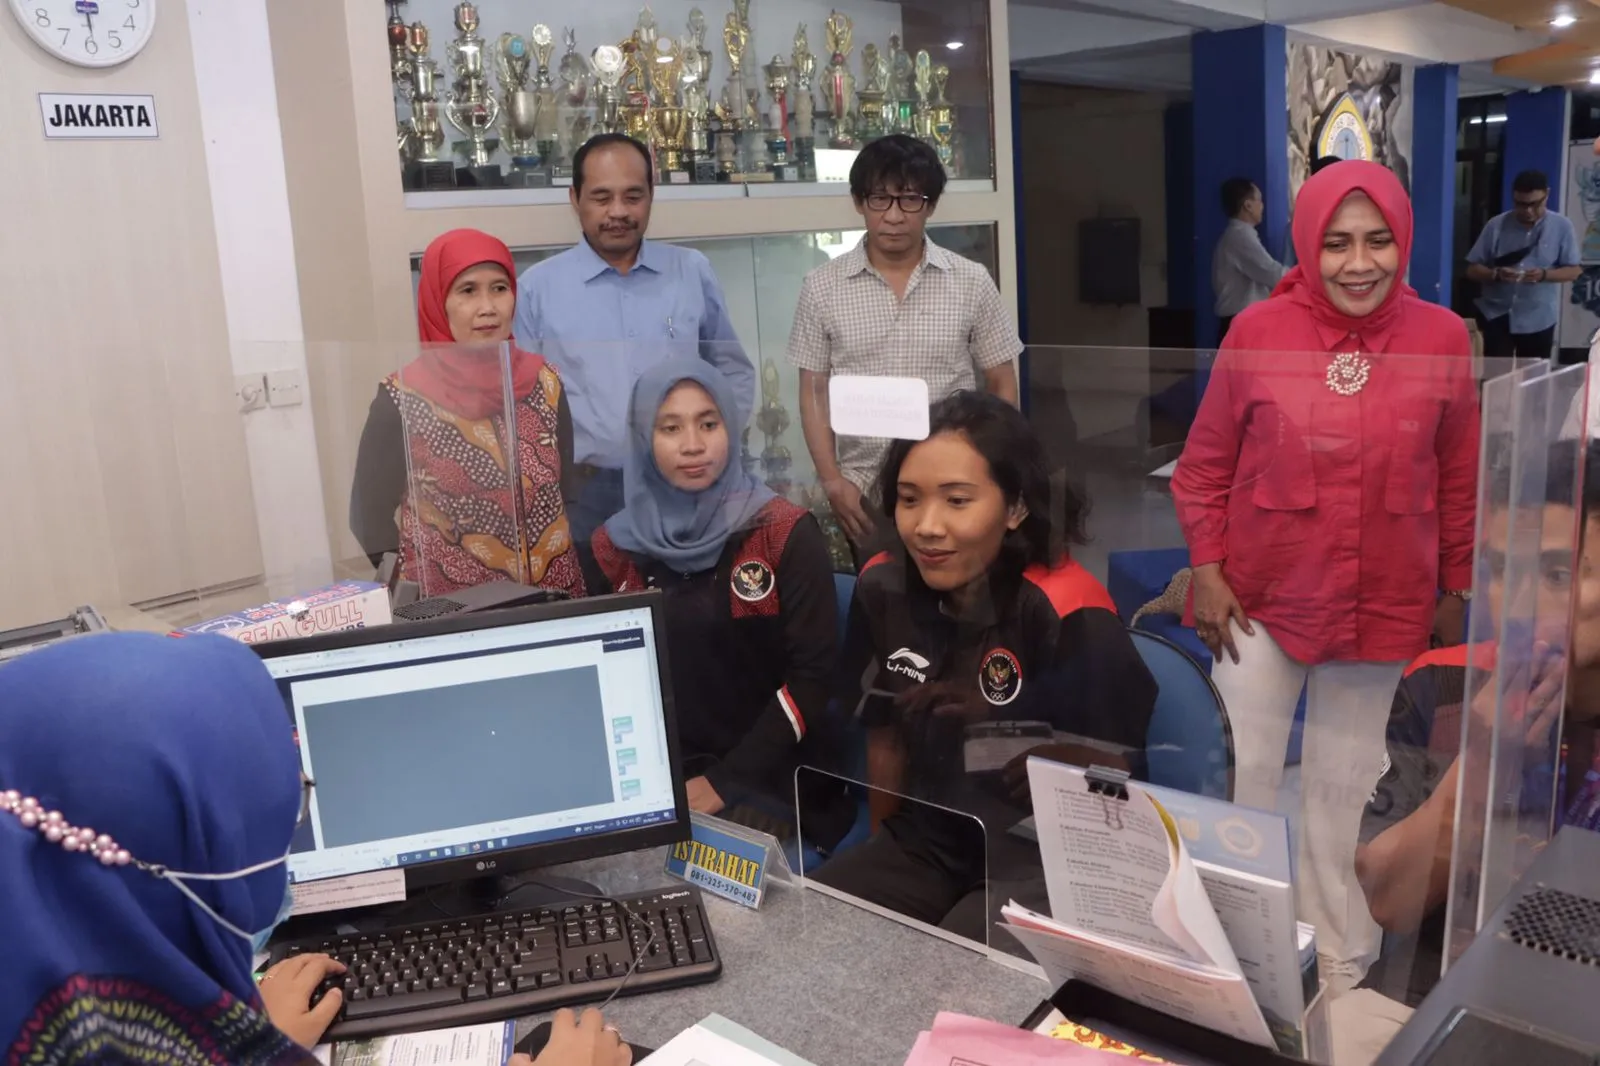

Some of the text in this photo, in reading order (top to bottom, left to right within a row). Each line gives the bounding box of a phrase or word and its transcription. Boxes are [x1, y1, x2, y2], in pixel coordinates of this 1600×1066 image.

[35, 8, 51, 27] 8
[122, 14, 136, 31] 4
[57, 28, 70, 46] 7
[84, 35, 99, 55] 6
[108, 30, 122, 49] 5
[49, 103, 151, 127] JAKARTA
[295, 600, 363, 637] GULL
[886, 661, 926, 683] LI-NING
[486, 861, 496, 869] LG
[674, 840, 759, 886] ISTIRAHAT
[662, 891, 690, 899] logitech
